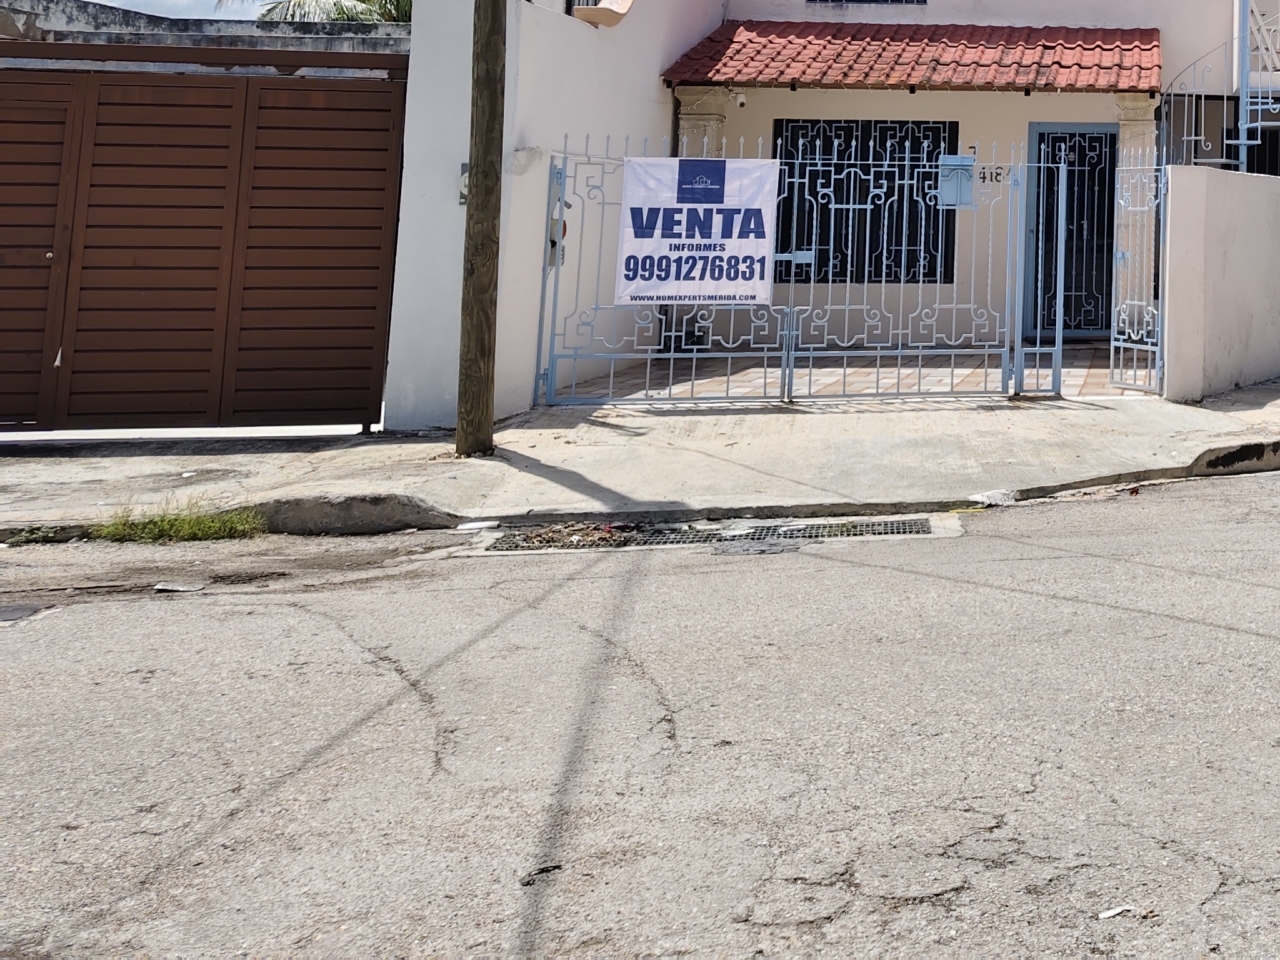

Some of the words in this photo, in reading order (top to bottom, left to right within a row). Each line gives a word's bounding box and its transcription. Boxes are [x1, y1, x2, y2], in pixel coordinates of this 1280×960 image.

[630, 207, 766, 239] VENTA
[668, 243, 726, 252] INFORMES
[623, 254, 766, 281] 9991276831
